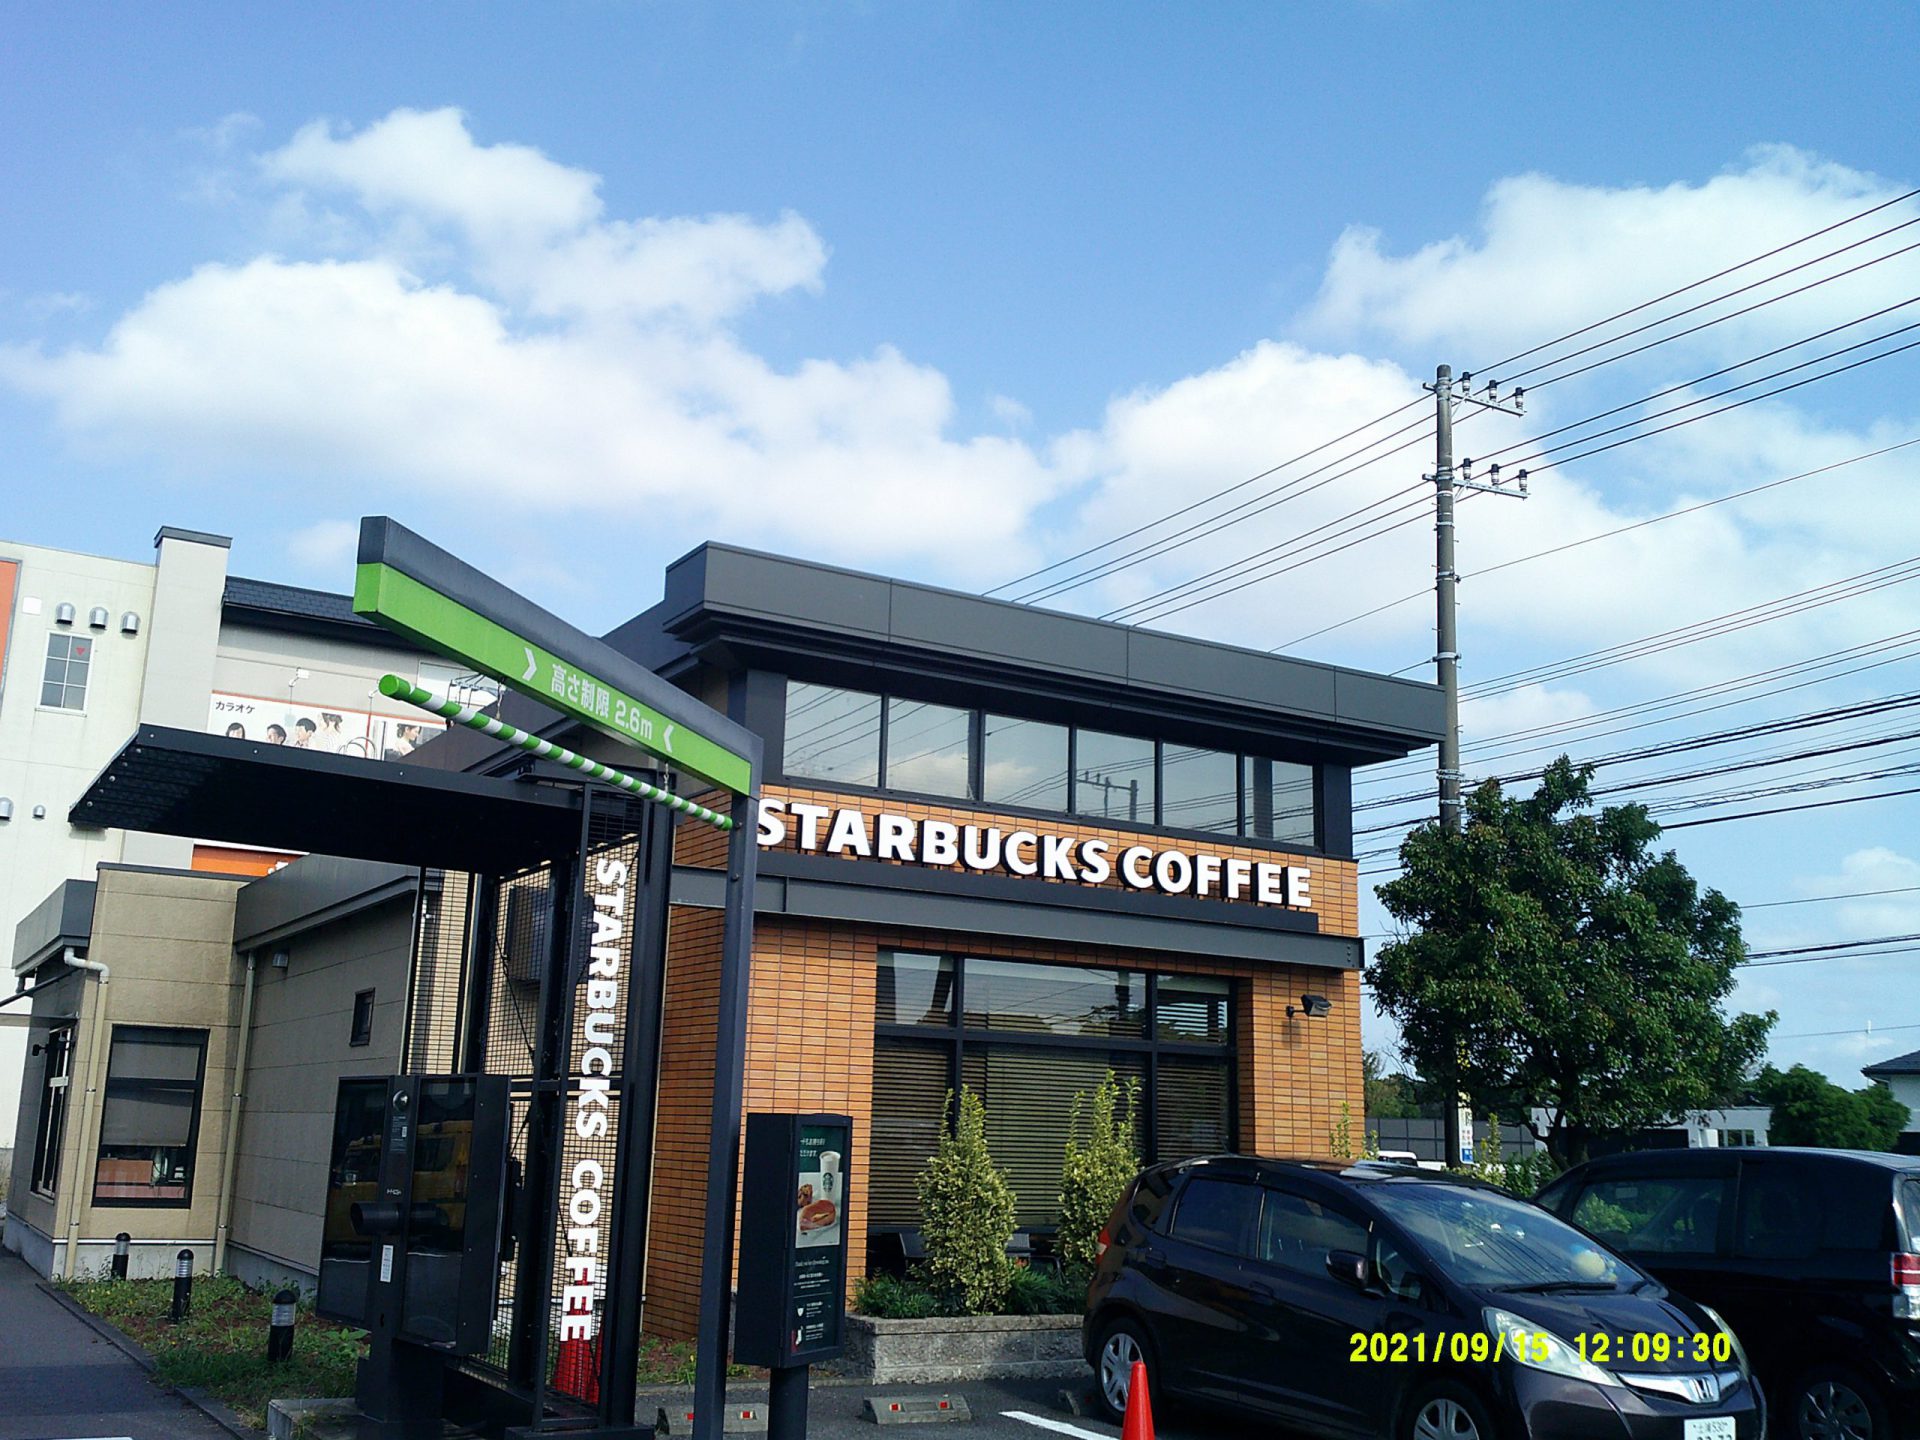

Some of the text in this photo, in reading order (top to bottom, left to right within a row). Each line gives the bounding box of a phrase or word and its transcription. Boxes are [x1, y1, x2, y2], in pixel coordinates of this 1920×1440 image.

[215, 701, 256, 714] カラオケ
[551, 663, 653, 740] 高さ制限 2.6m
[756, 798, 1312, 908] STARBUCKS COFFEE
[559, 858, 629, 1342] STARBUCKS COFFEE
